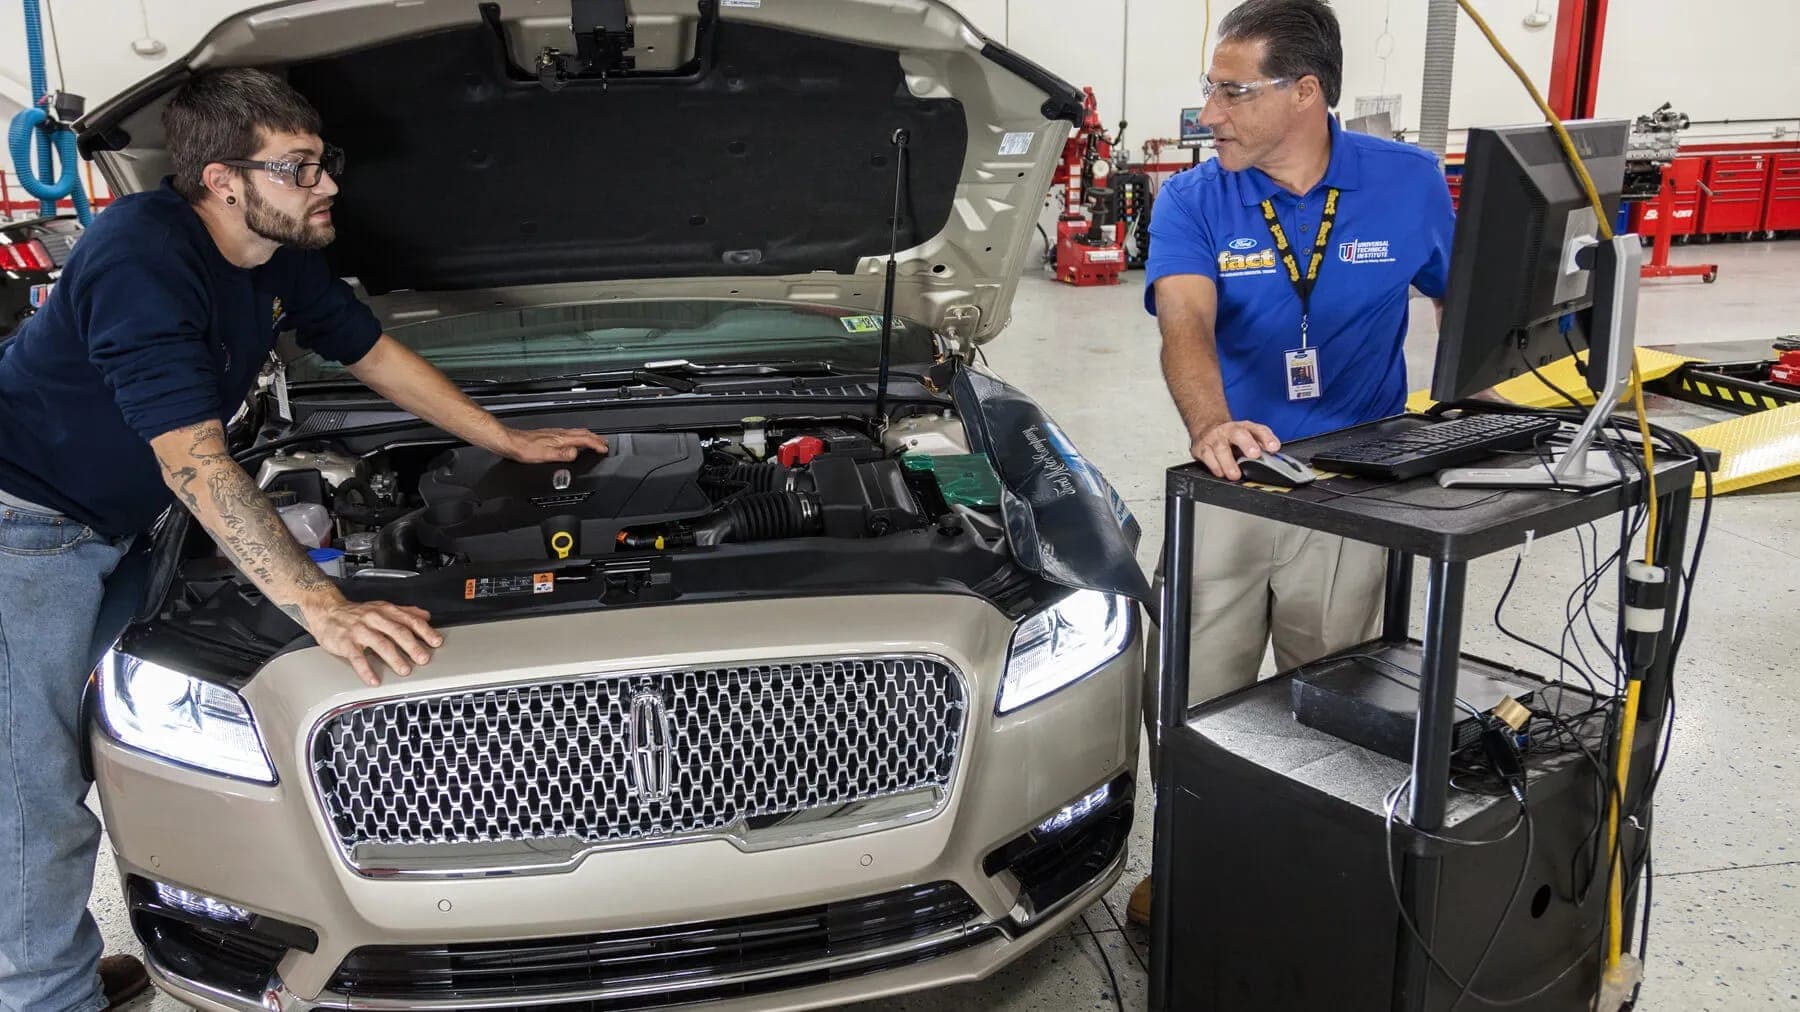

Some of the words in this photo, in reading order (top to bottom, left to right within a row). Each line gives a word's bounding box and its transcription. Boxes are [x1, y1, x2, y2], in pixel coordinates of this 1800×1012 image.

[1357, 240, 1389, 248] UNIVERSAL
[1217, 248, 1276, 272] fact
[1356, 252, 1388, 260] INSTITUTE
[1022, 424, 1049, 462] Company
[1043, 455, 1071, 479] Motor
[1052, 475, 1076, 496] Ford
